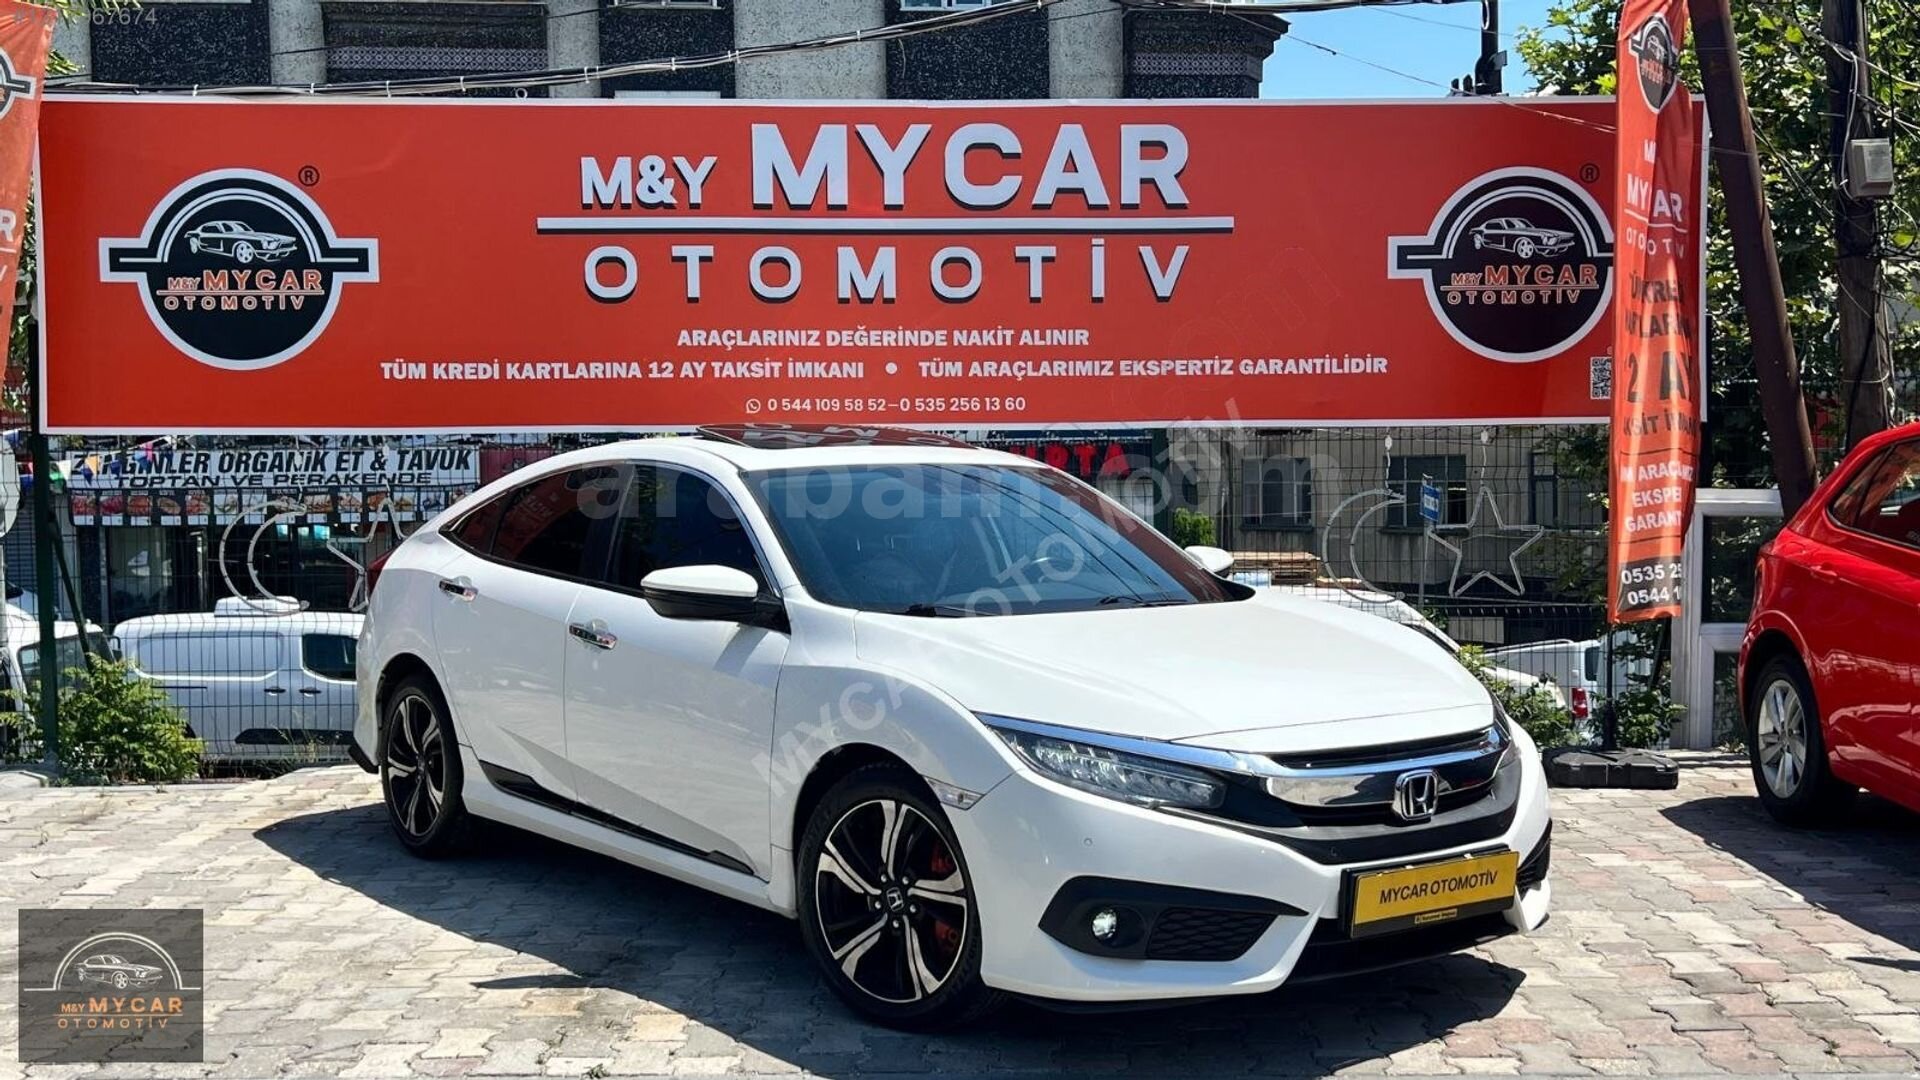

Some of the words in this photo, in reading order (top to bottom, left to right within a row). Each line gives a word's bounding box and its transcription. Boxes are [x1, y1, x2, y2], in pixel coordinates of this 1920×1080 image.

[581, 155, 717, 209] M&Y
[752, 123, 1189, 210] MYCAR
[1627, 173, 1683, 222] MYAR
[168, 278, 200, 291] M&Y
[203, 269, 322, 291] MYCAR
[585, 238, 1189, 303] OTOMOTİV
[1451, 273, 1482, 286] M&Y
[1485, 264, 1597, 286] MYCAR
[677, 329, 820, 351] ARAÇLARINIZ
[826, 325, 948, 347] DEĞERİNDE
[953, 326, 1014, 346] NAKİT
[1019, 329, 1089, 346] ALINIR
[381, 358, 426, 379] TÜM
[433, 358, 499, 379] KREDİ
[506, 362, 642, 380] KARTLARINA
[649, 361, 674, 378] 12
[680, 361, 706, 378] AY
[711, 357, 783, 379] TAKSİT
[788, 357, 864, 378] İMKANI
[918, 357, 963, 377] TÜM
[968, 359, 1114, 382] ARAÇLARIMIZ
[1119, 355, 1234, 376] EKSPERTİZ
[1239, 354, 1388, 375] GARANTİLİDİR
[767, 399, 777, 412] 0
[782, 399, 812, 412] 544
[816, 399, 840, 411] 109
[844, 399, 864, 411] 58
[915, 398, 946, 411] 535
[950, 397, 981, 411] 256
[984, 397, 1001, 411] 13
[1005, 397, 1026, 411] 60
[335, 452, 363, 471] ET
[370, 452, 386, 471] &
[397, 450, 471, 471] TAVUK
[116, 475, 221, 487] TOPTAN
[231, 474, 263, 486] VE
[273, 472, 431, 486] PERAKENDE
[1622, 564, 1665, 585] 0535
[1628, 586, 1670, 606] 0544
[1380, 882, 1428, 905] MYCAR
[1430, 869, 1498, 896] OTOMOTİV
